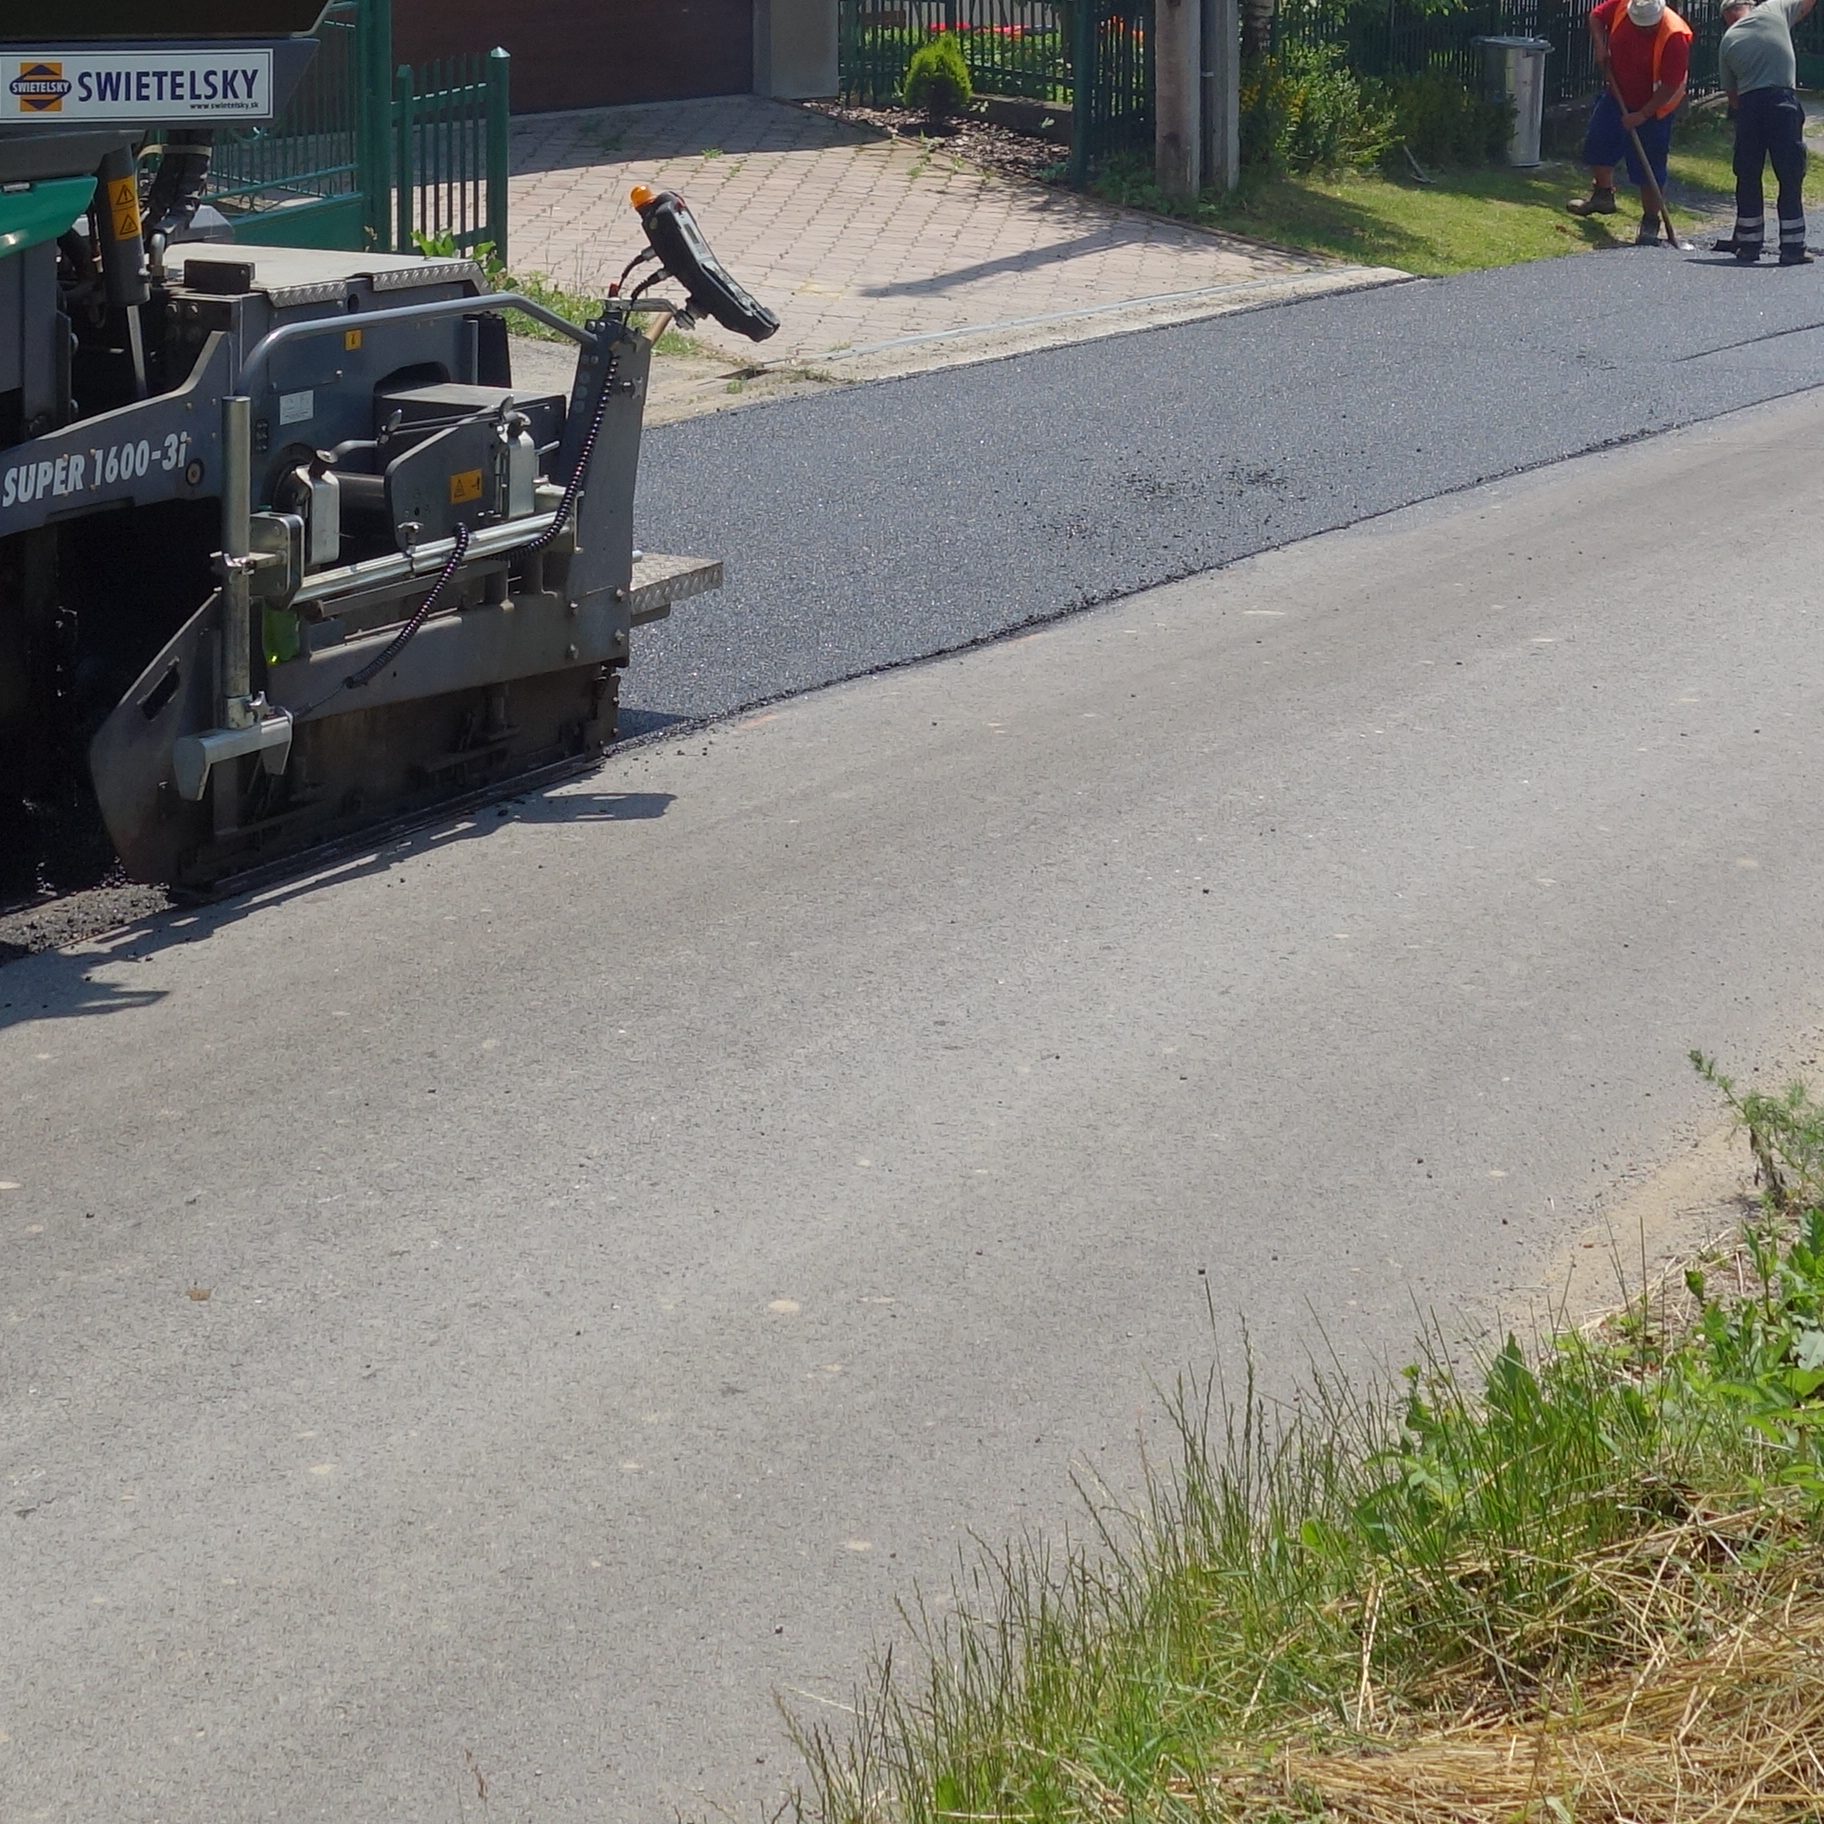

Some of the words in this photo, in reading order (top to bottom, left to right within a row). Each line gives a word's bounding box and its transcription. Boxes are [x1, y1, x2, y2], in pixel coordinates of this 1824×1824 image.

[11, 81, 70, 94] SWIETELSKY
[77, 69, 260, 102] SWIETELSKY
[2, 454, 86, 508] SUPER
[93, 430, 188, 486] 1600-3i
